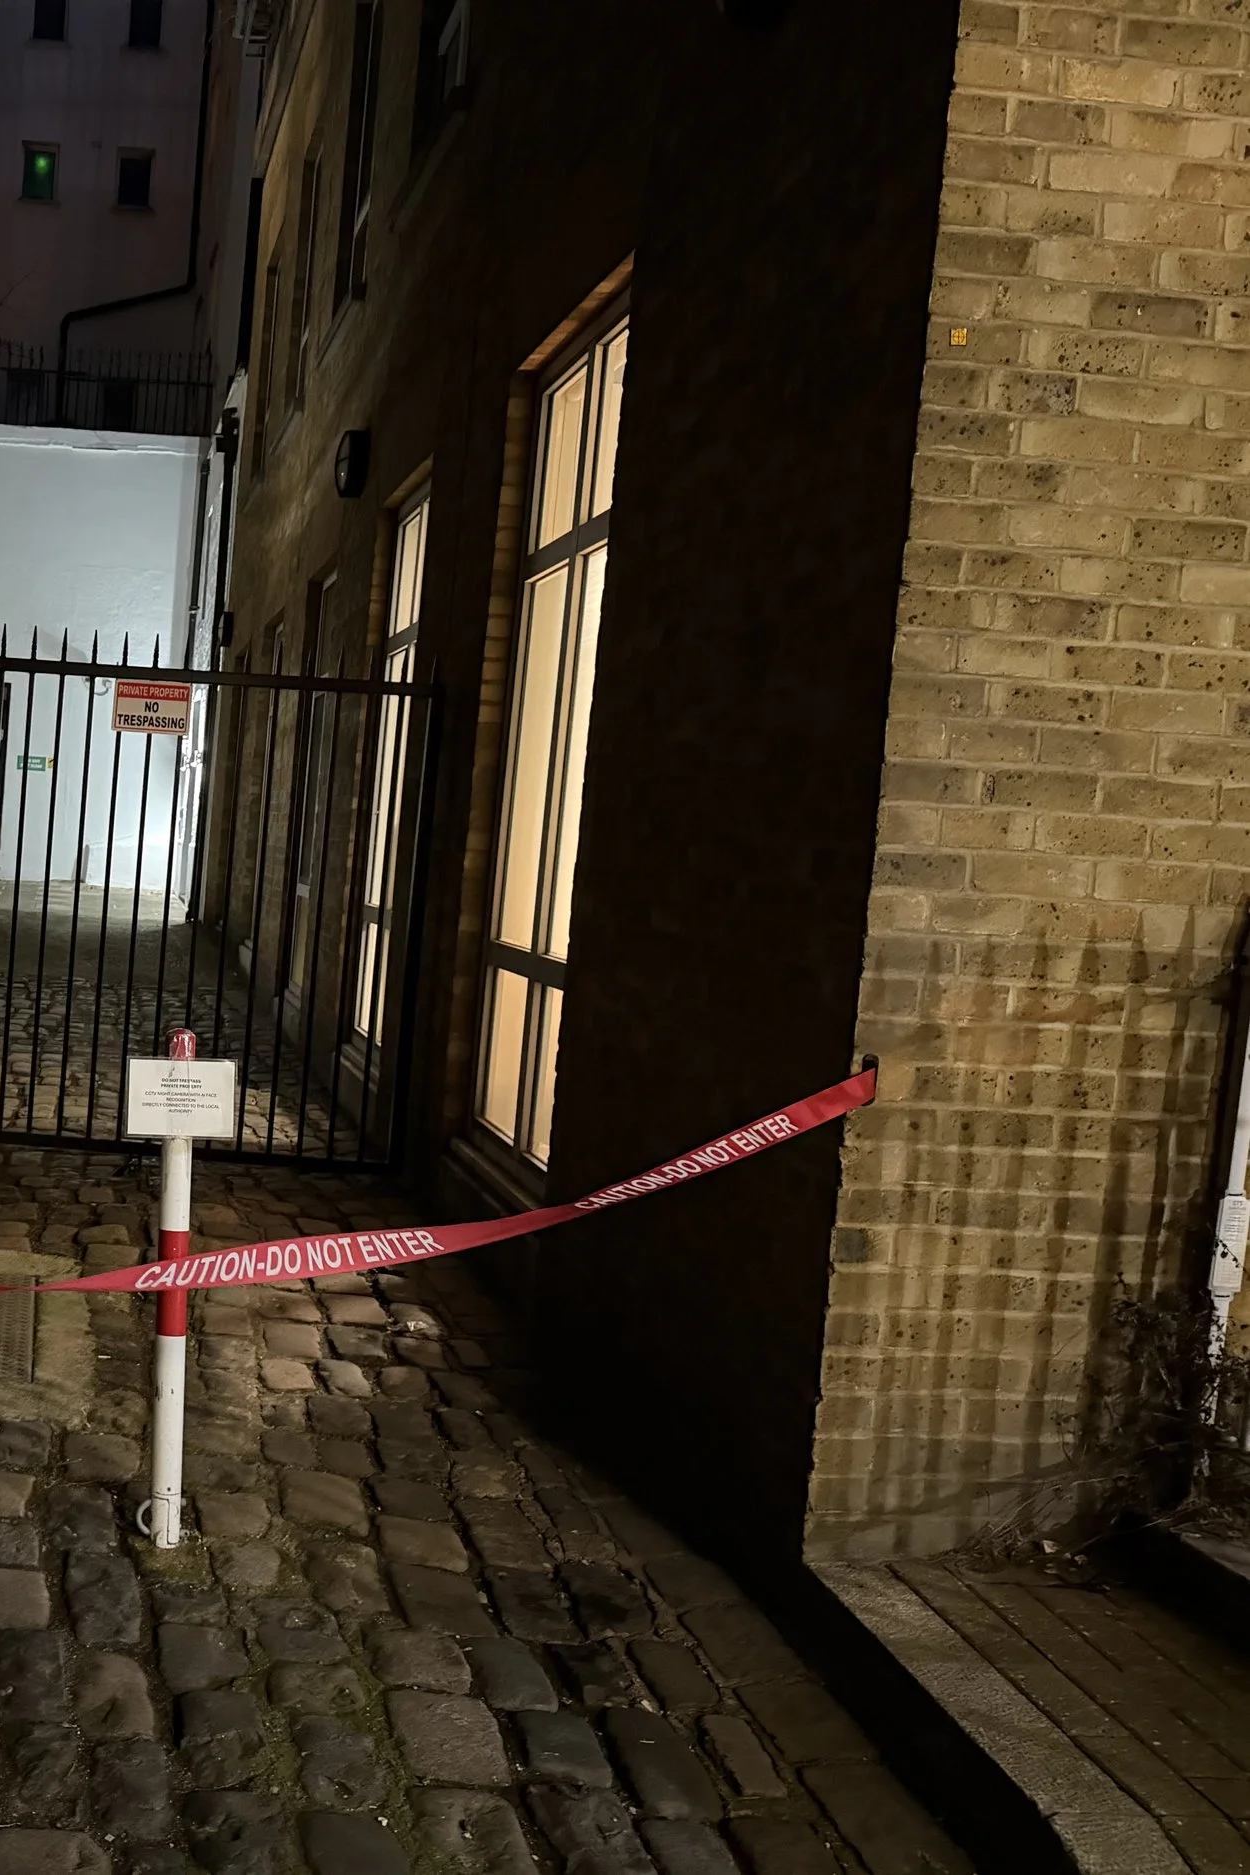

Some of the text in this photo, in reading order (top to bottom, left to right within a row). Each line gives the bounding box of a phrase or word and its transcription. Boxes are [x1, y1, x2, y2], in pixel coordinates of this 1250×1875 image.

[118, 684, 189, 699] PRIVATE PROPERTY
[144, 701, 160, 714] NO
[117, 713, 185, 730] TRESPASSING
[575, 1114, 799, 1210] CAUTION-DO NOT ENTER
[135, 1229, 445, 1289] CAUTION-DO NOT ENTER
